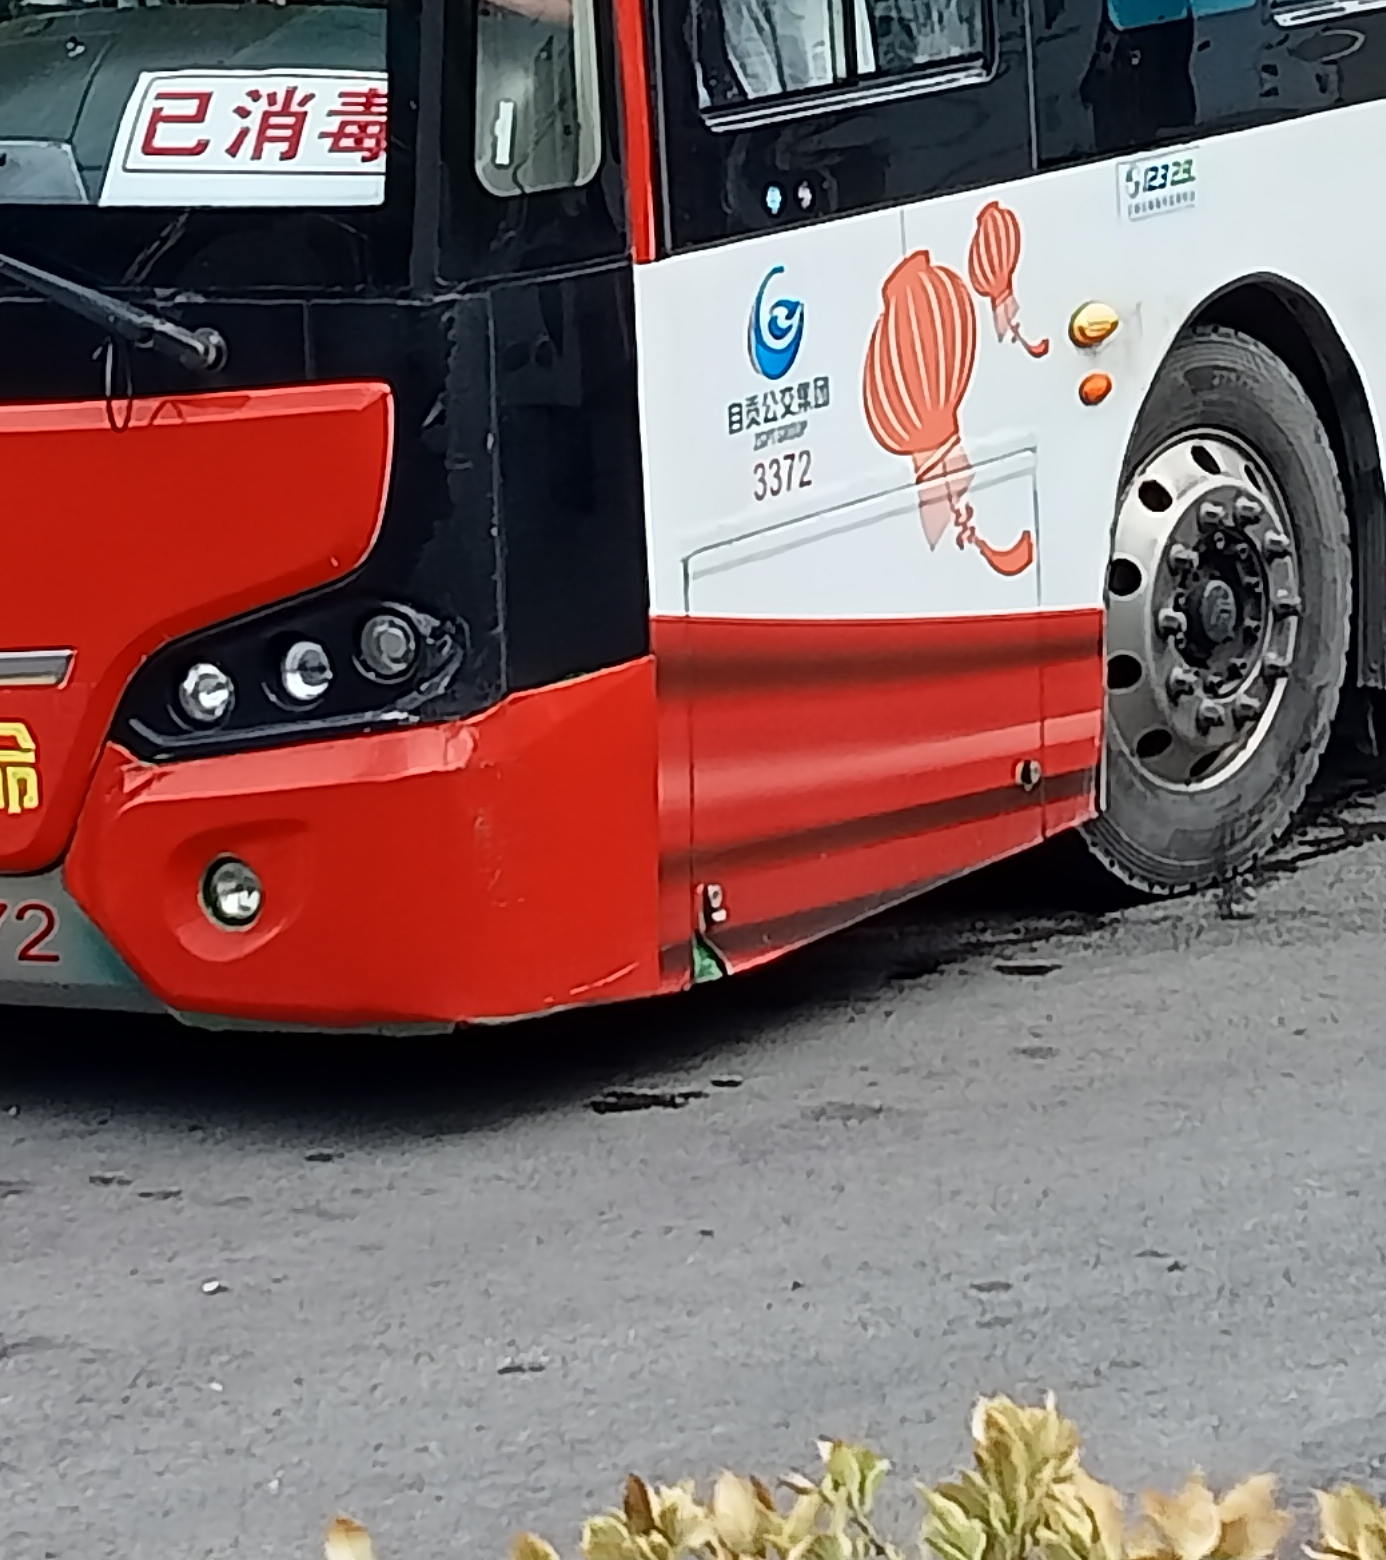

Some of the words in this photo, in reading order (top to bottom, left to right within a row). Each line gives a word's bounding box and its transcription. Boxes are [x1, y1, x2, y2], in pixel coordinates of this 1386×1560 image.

[140, 85, 389, 163] 已消毒
[728, 376, 831, 435] 自贡公交集团
[753, 449, 813, 502] 3372
